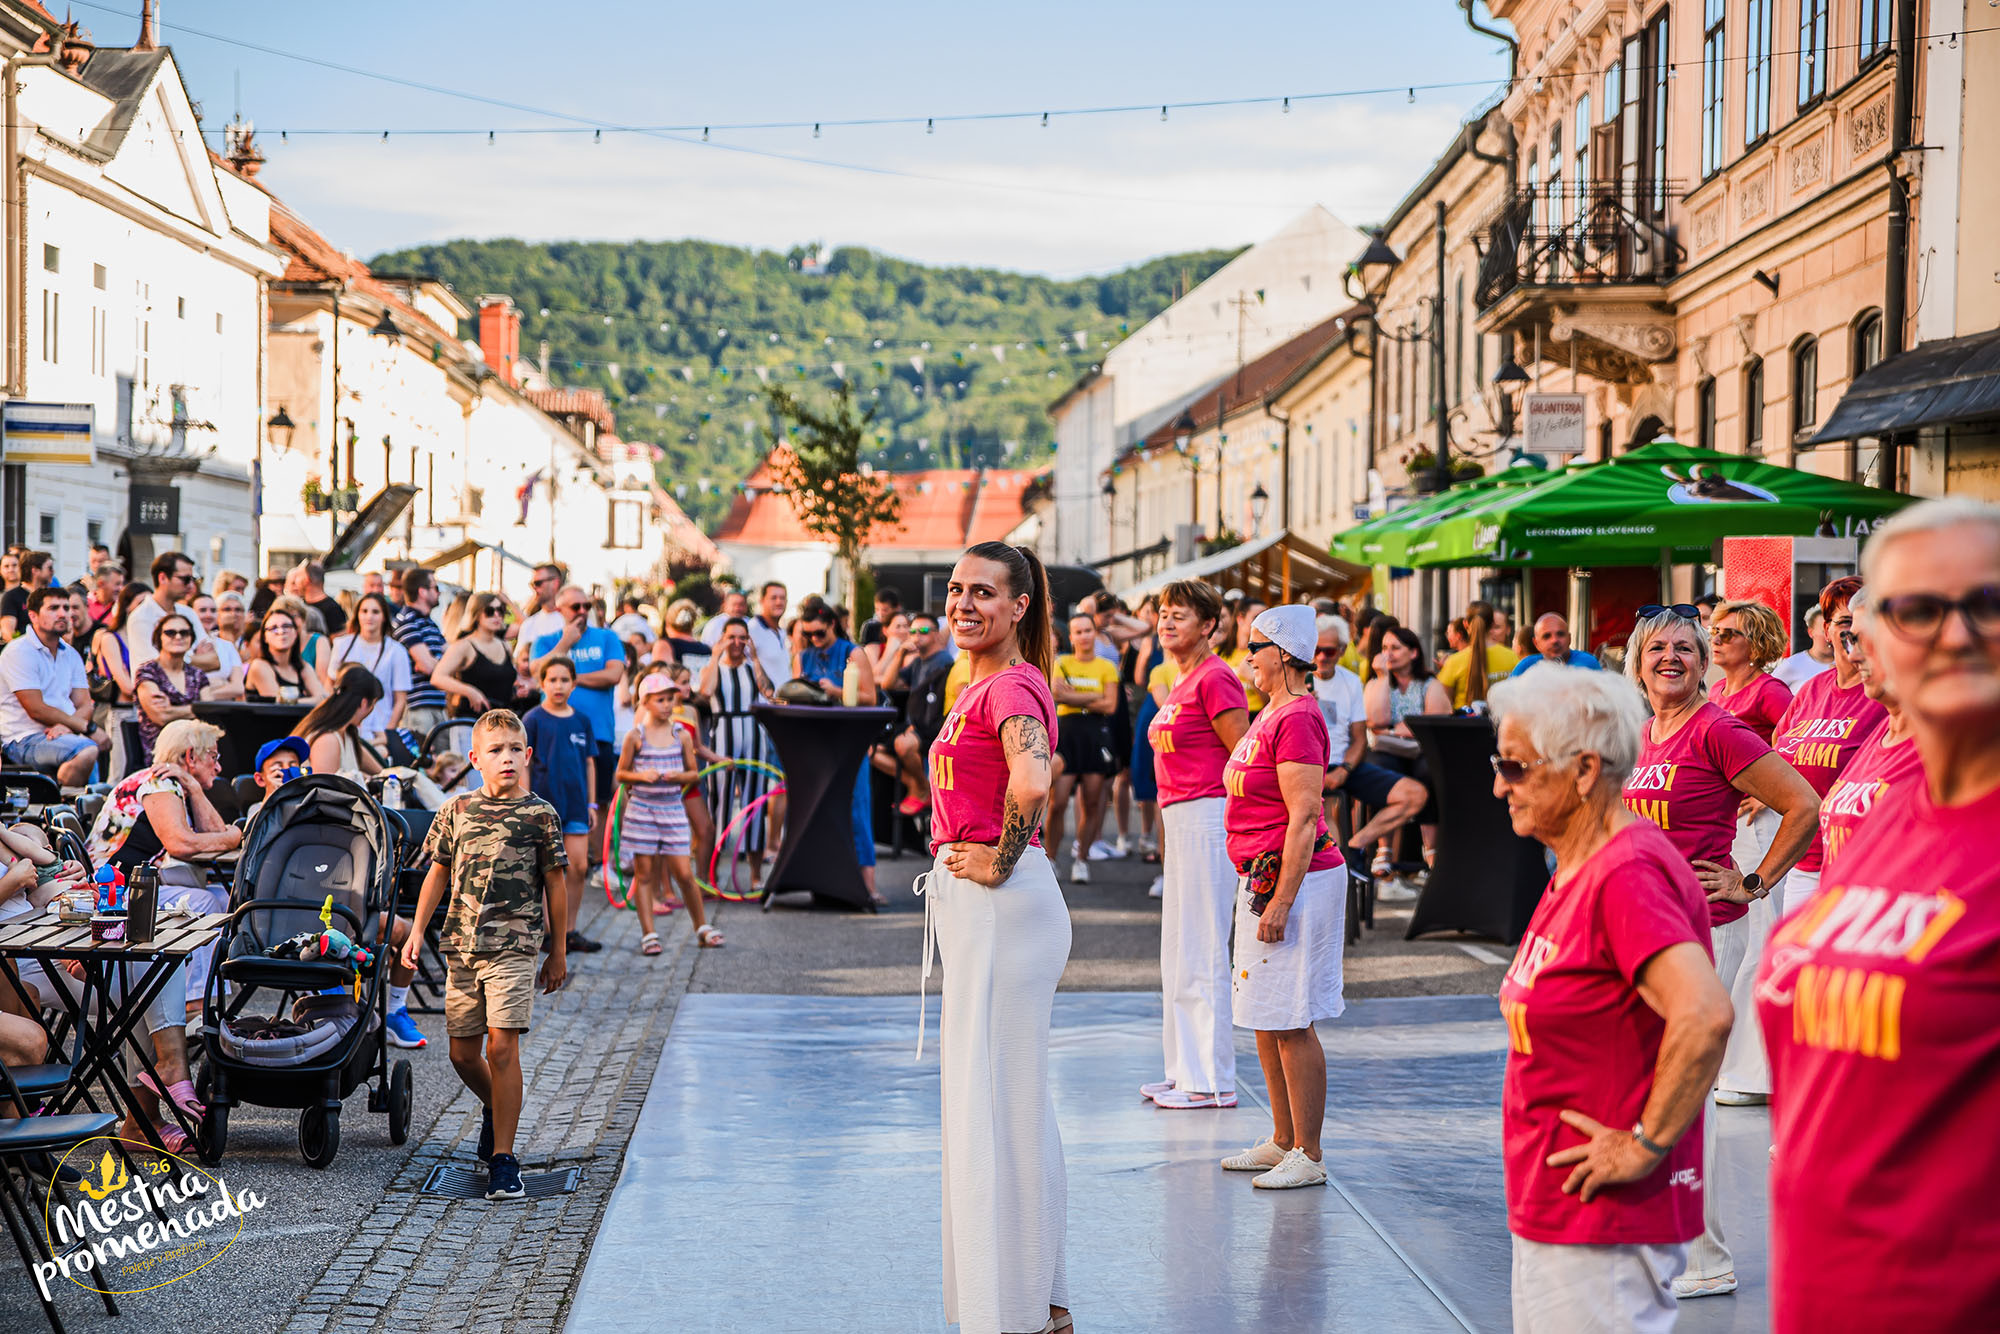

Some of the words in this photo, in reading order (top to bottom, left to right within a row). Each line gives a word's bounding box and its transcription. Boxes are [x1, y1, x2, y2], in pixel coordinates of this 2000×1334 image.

[1526, 526, 1593, 537] LEGENDARNO
[1596, 524, 1656, 535] SLOVENSKO
[1785, 717, 1858, 740] ZAPLEŠI
[1792, 742, 1842, 768] NAMI
